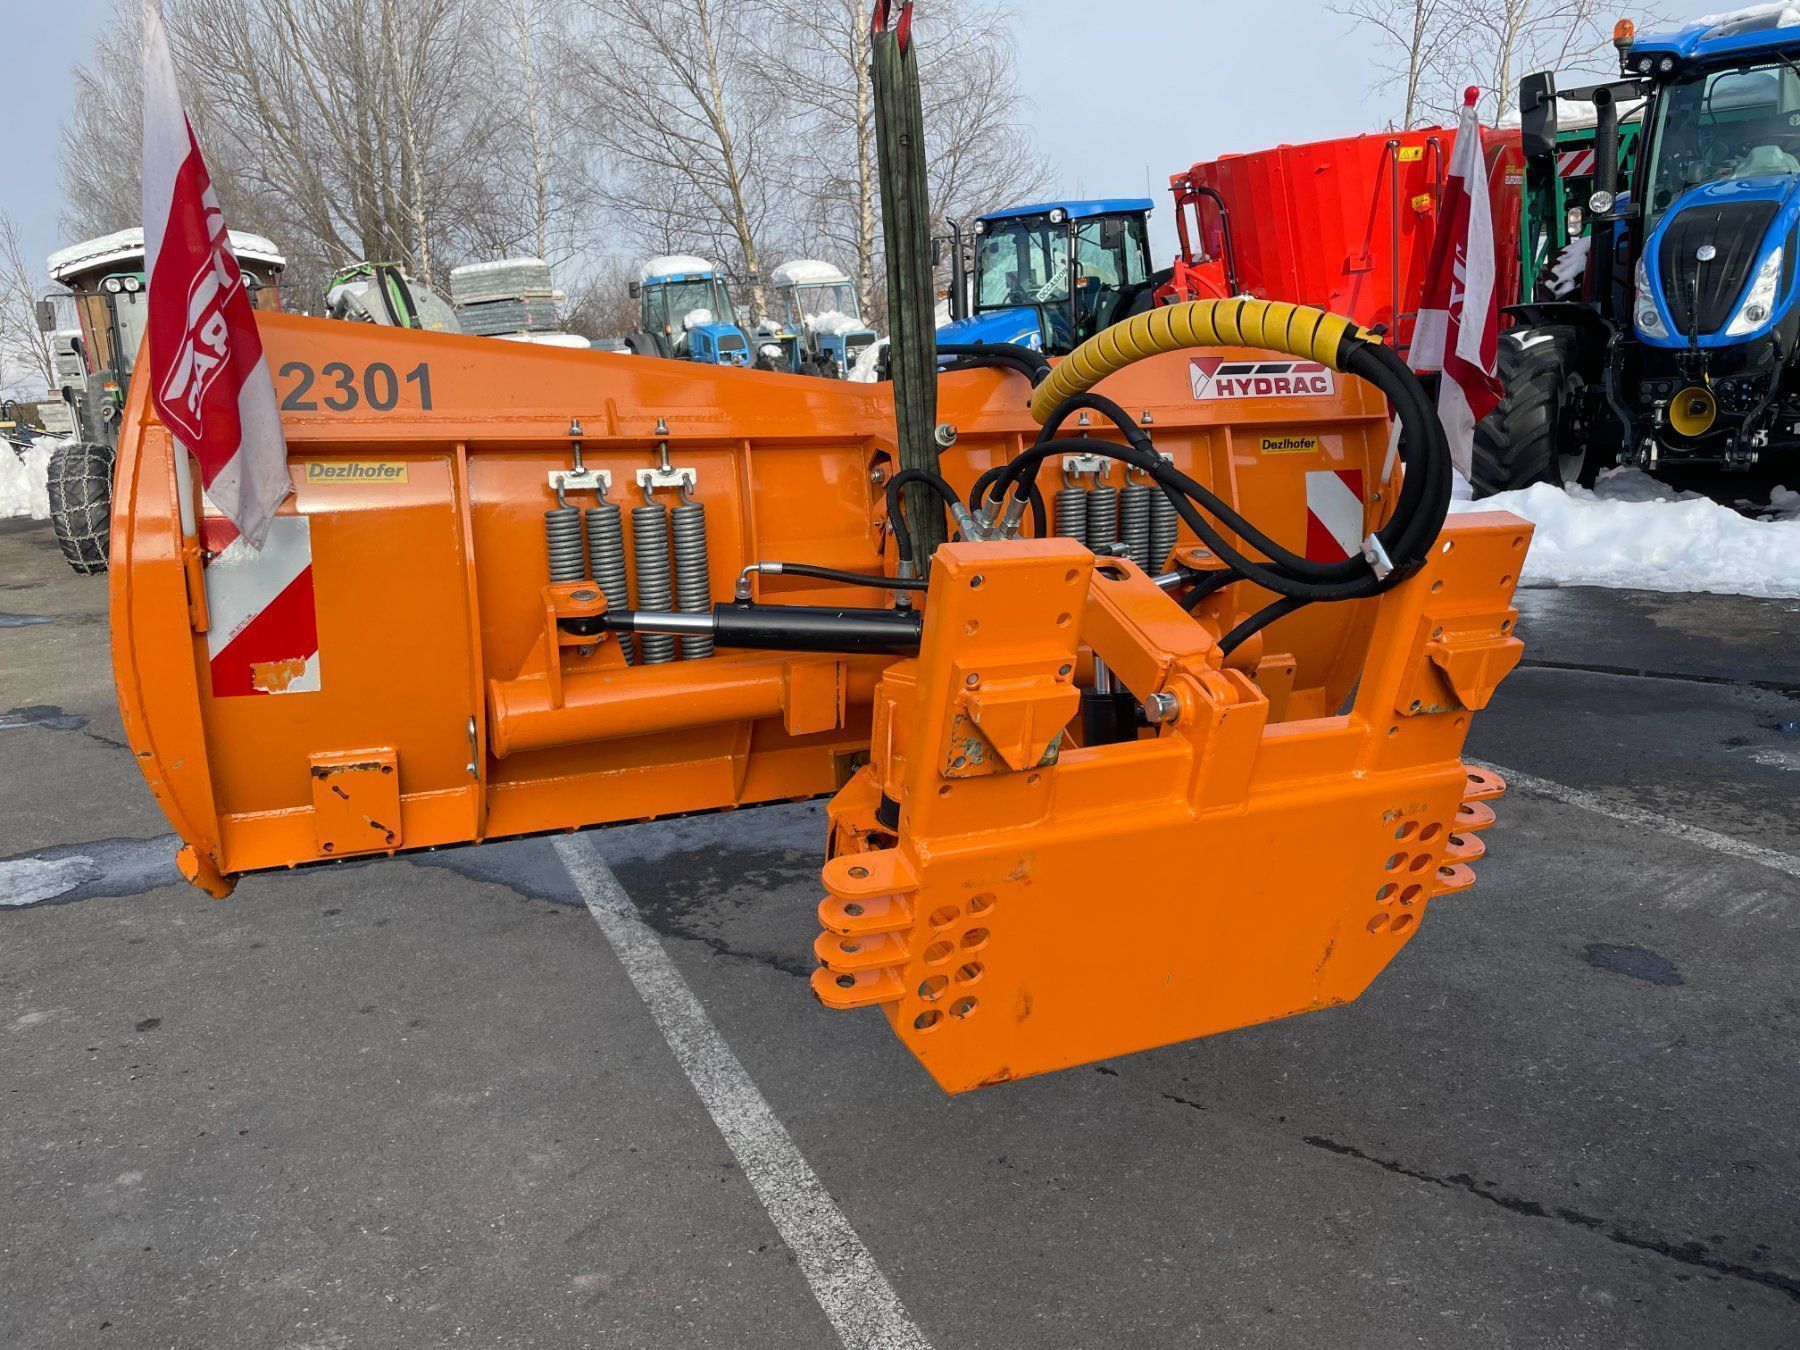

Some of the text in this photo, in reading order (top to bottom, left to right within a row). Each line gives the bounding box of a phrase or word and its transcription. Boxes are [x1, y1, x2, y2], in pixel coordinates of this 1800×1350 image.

[275, 361, 433, 412] 2301
[1215, 376, 1328, 396] HYDRAC
[1262, 438, 1316, 450] Dezlhofer
[308, 463, 405, 478] Dezlhofer
